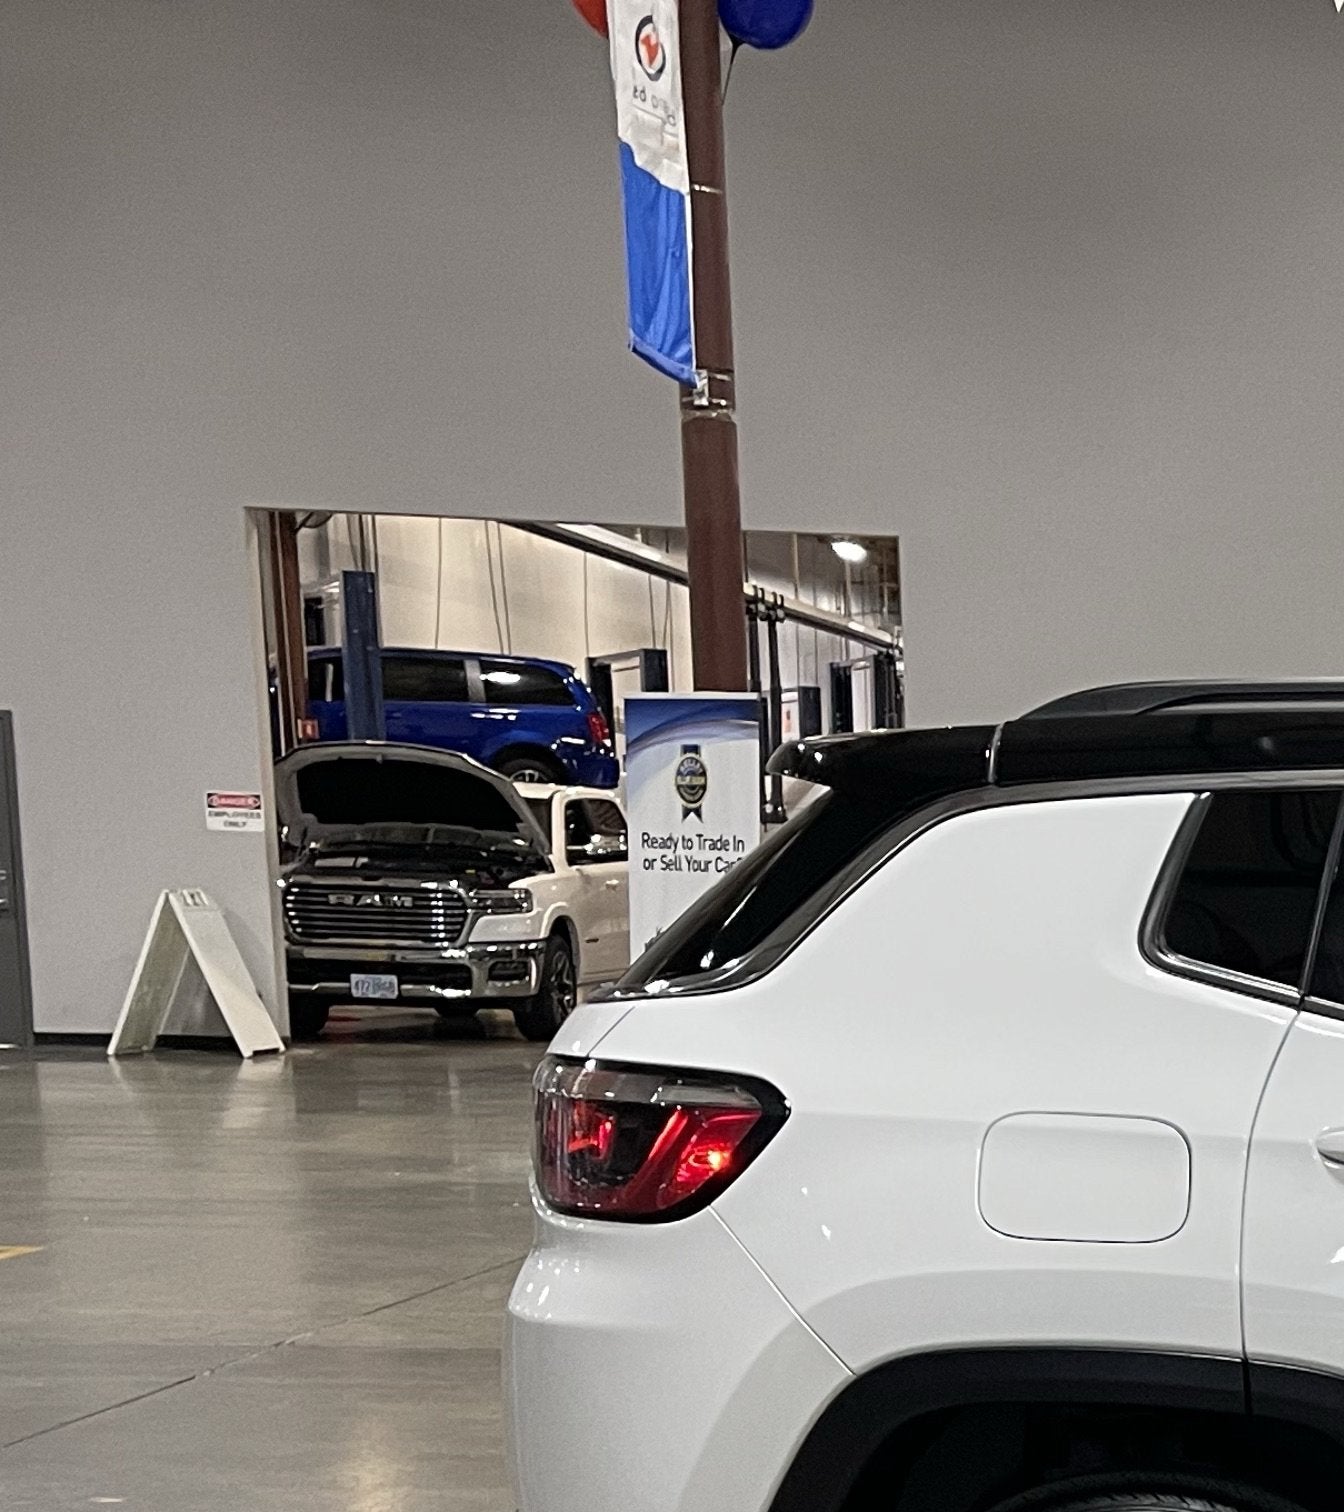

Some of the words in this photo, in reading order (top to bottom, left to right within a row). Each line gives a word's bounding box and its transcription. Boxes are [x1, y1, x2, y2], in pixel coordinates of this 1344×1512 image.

[641, 832, 679, 853] Ready
[682, 835, 693, 851] to
[696, 833, 730, 852] Trade
[733, 835, 745, 853] In
[643, 858, 657, 871] or
[660, 855, 683, 872] Sell
[685, 855, 712, 873] Your
[328, 894, 413, 907] RAM
